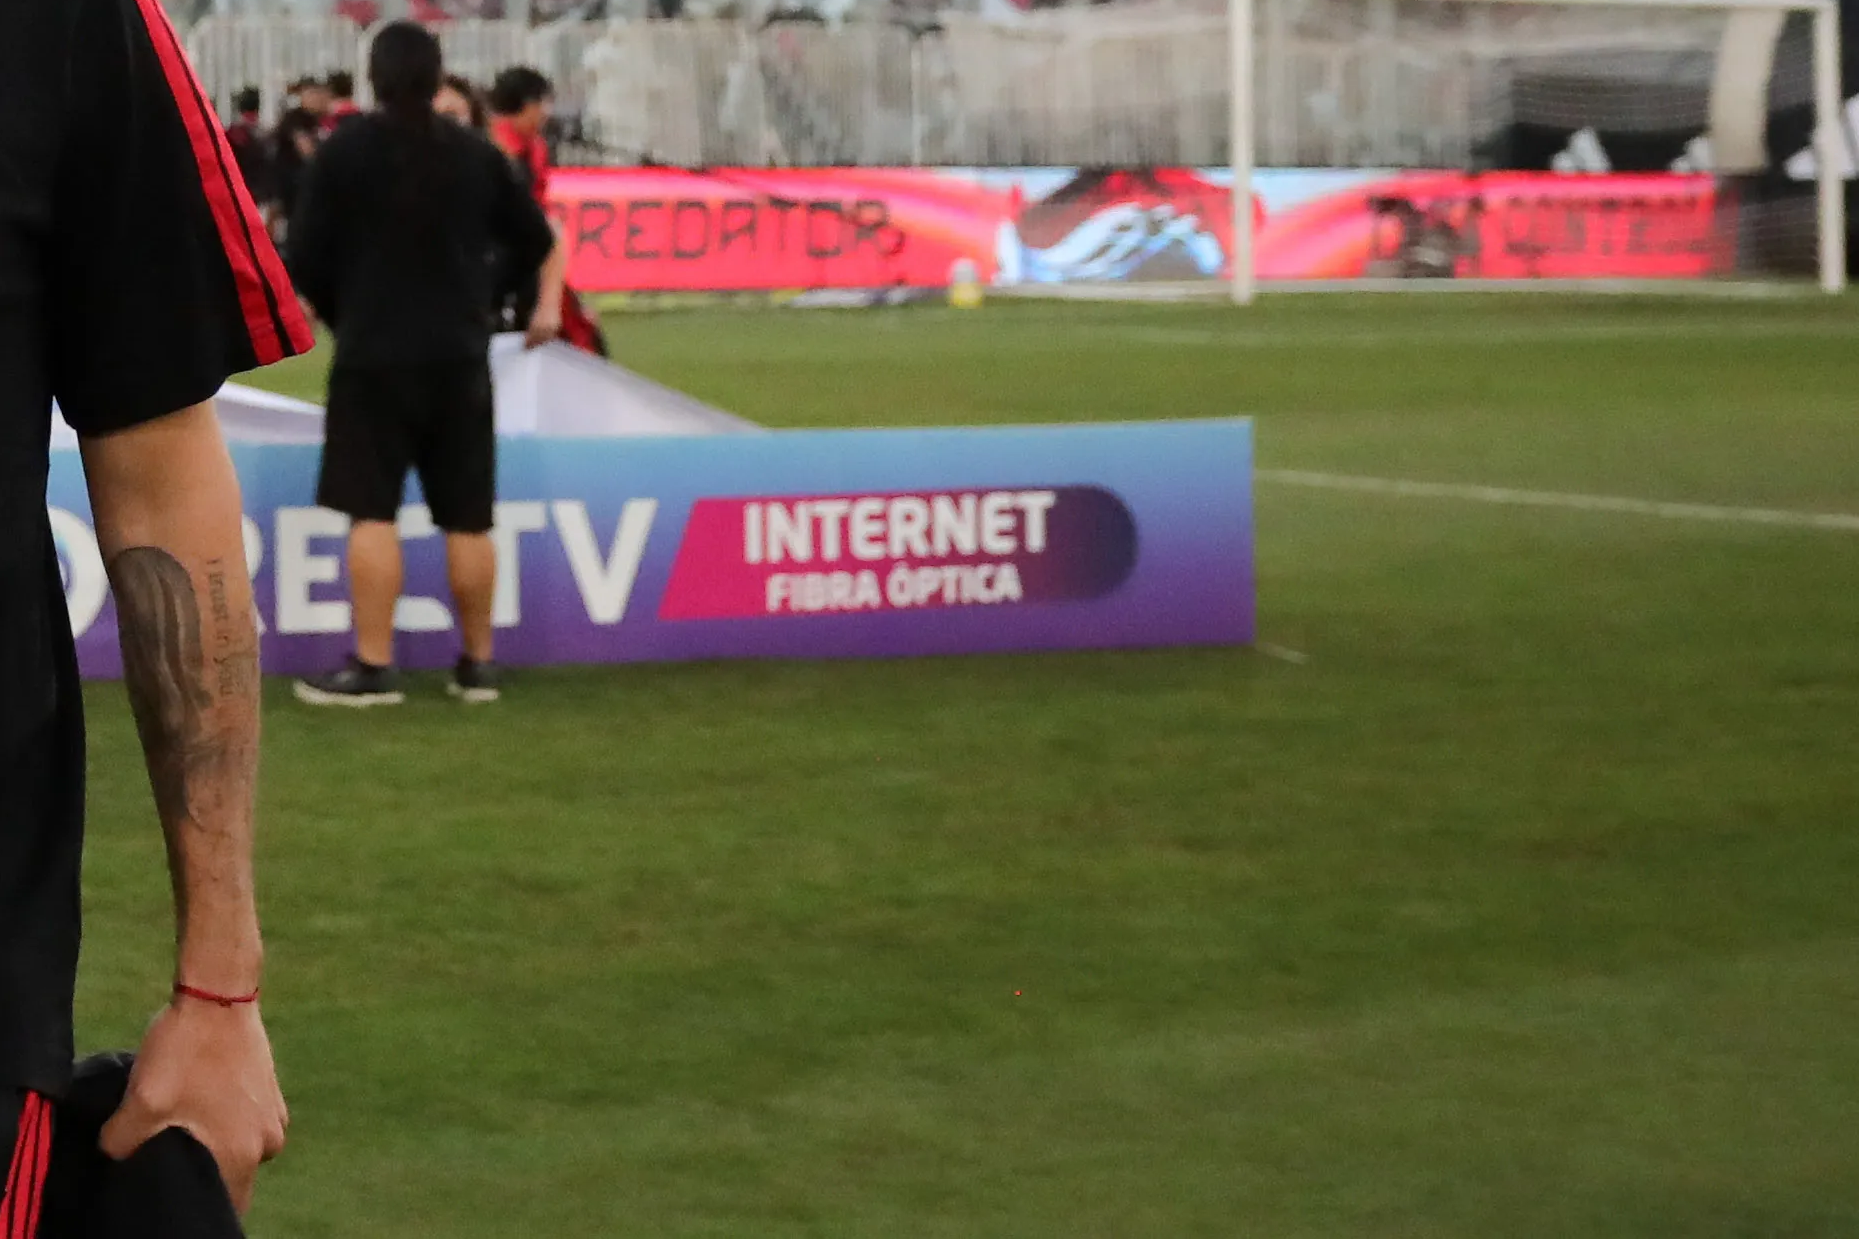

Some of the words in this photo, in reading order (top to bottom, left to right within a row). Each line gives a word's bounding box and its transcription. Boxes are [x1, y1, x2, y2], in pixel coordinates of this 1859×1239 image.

[744, 489, 1057, 565] INTERNET
[765, 568, 880, 614] FIBRA
[886, 561, 1024, 610] ÓPTICA
